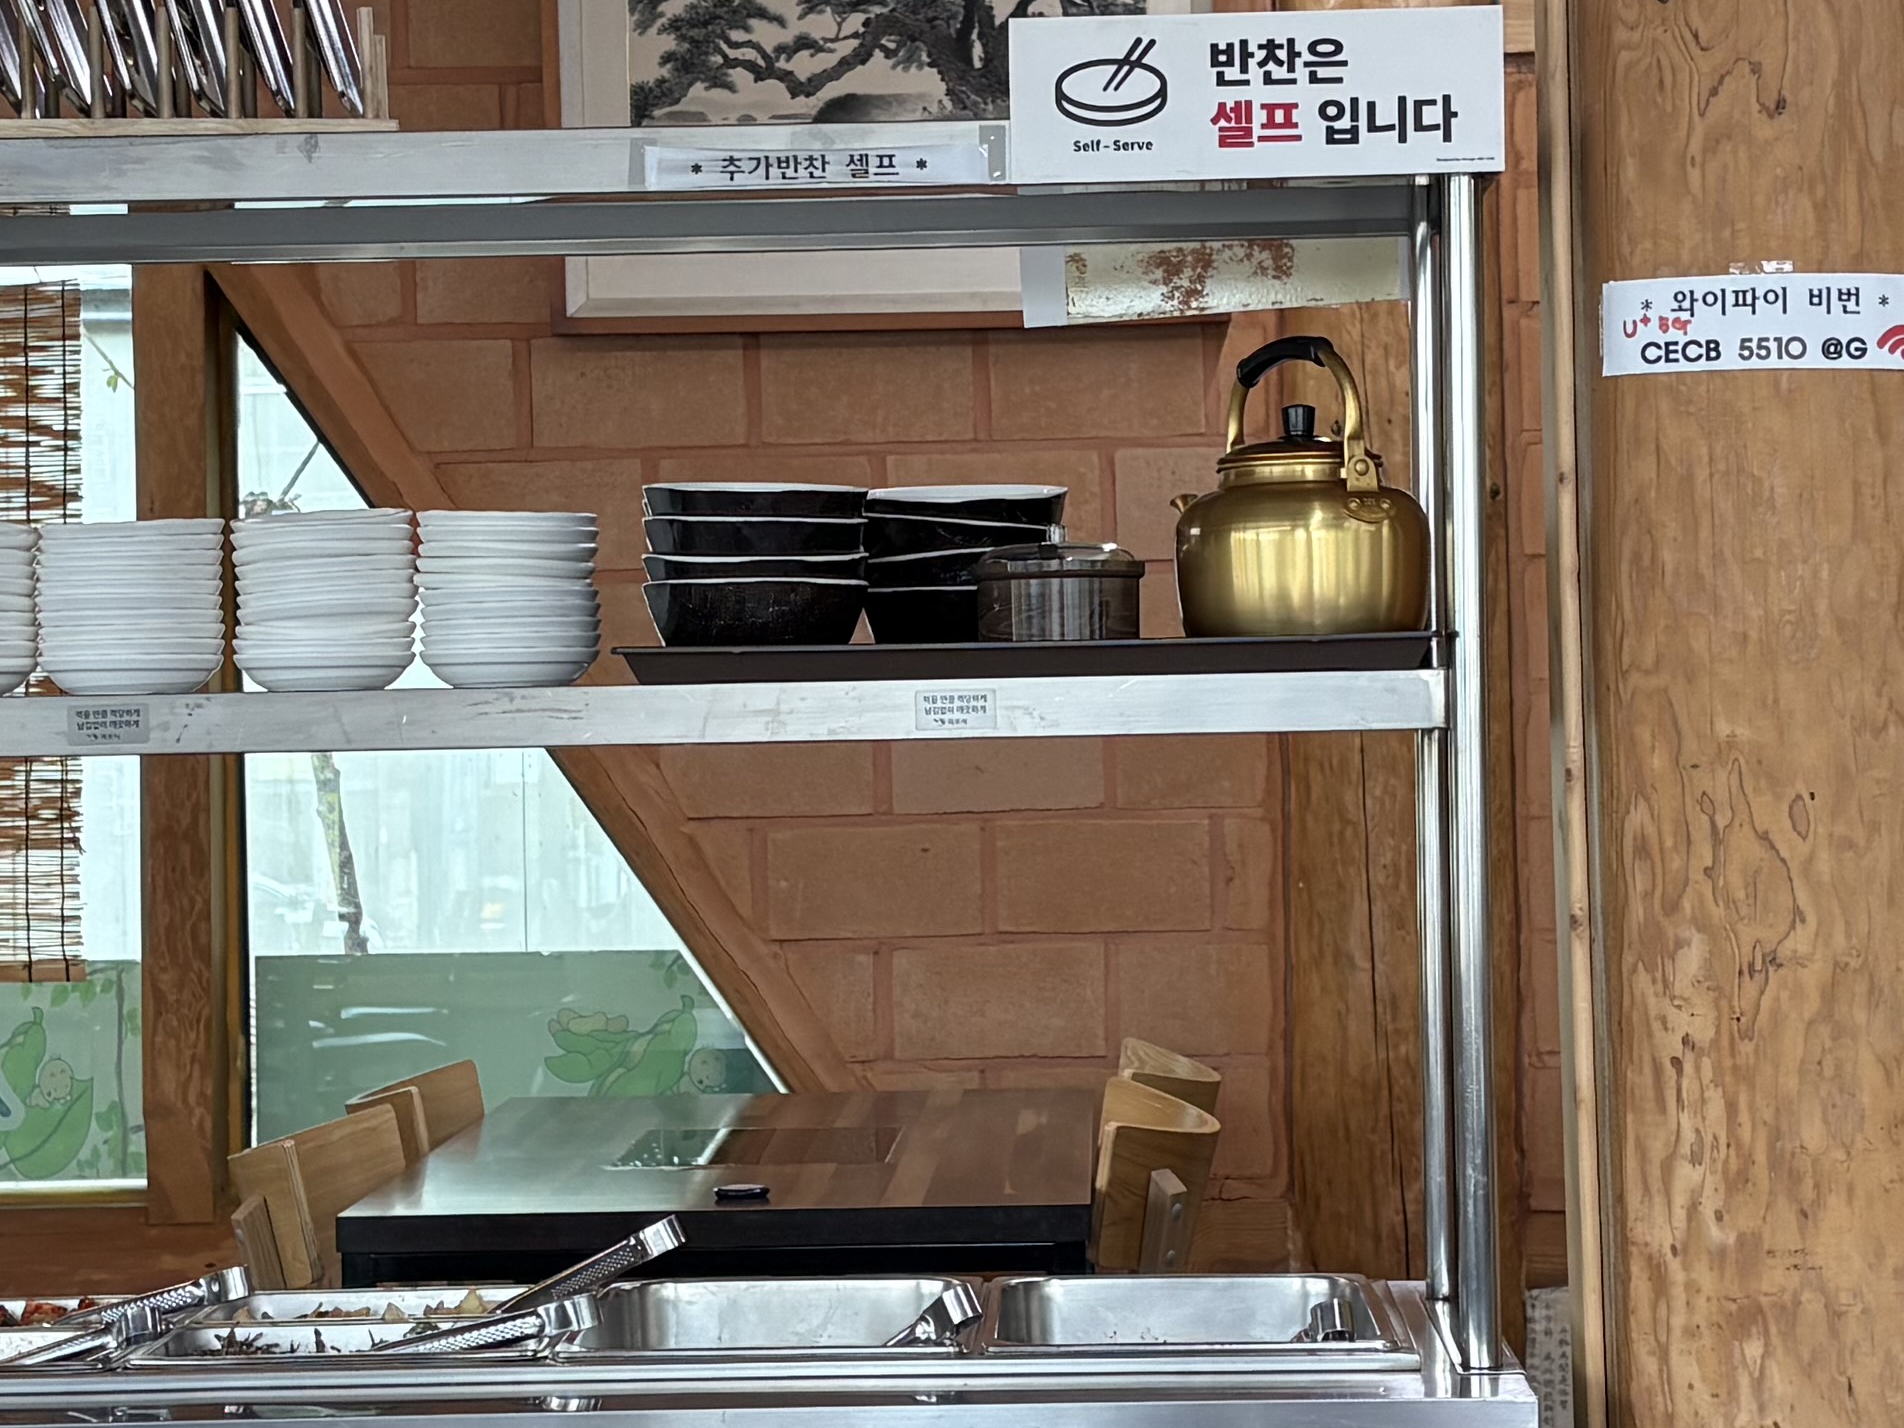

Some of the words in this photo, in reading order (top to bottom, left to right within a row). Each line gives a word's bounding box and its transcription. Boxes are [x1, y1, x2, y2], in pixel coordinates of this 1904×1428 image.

[1210, 37, 1348, 87] 반찬은
[1211, 99, 1303, 148] 셀프
[1318, 94, 1458, 145] 입니다
[719, 154, 830, 181] 추가반찬
[846, 153, 899, 179] 셀프
[1670, 286, 1788, 318] 와이파이
[1808, 286, 1861, 315] 비번
[1640, 339, 1722, 364] CECB
[1737, 337, 1807, 361] 5510
[1821, 337, 1868, 360] @G
